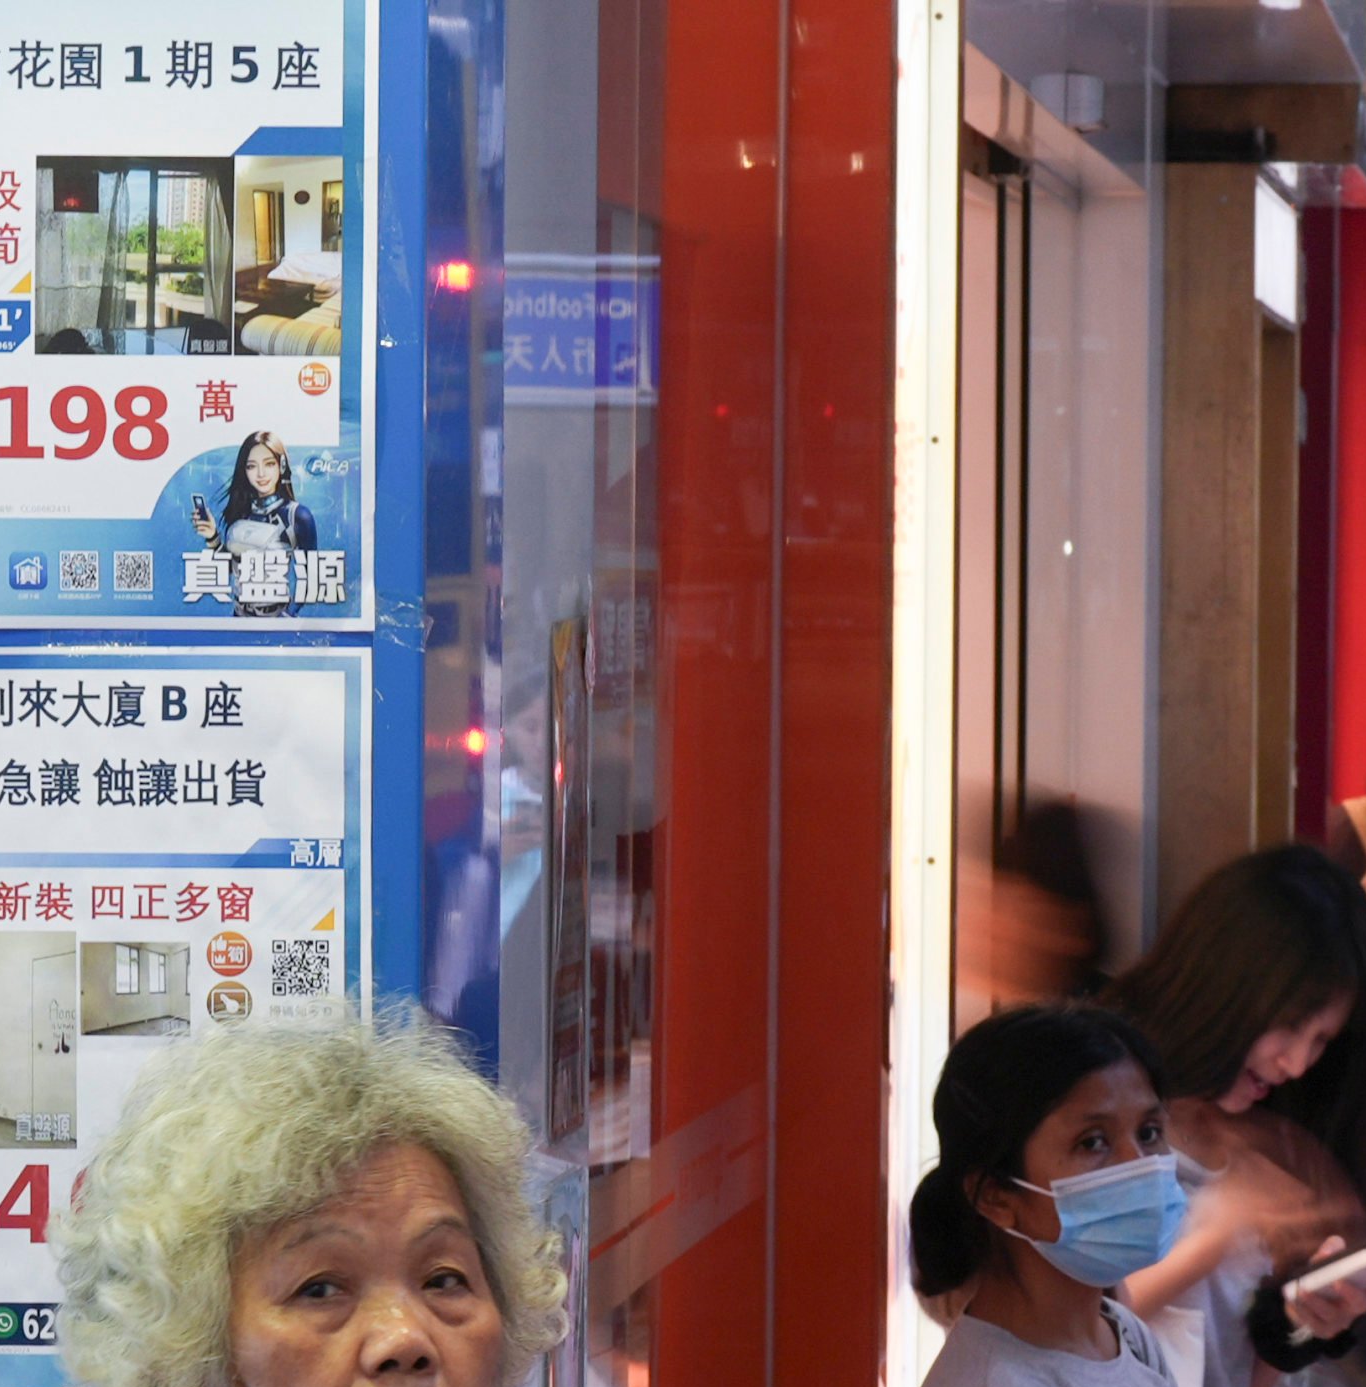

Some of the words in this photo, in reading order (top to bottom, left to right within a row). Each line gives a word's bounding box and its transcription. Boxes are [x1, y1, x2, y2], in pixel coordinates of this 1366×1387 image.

[196, 380, 237, 423] 萬
[182, 549, 345, 604] 真盤源
[93, 758, 266, 807] 蝕讓出貨
[289, 838, 342, 867] 高層
[92, 882, 253, 922] 四正多窗
